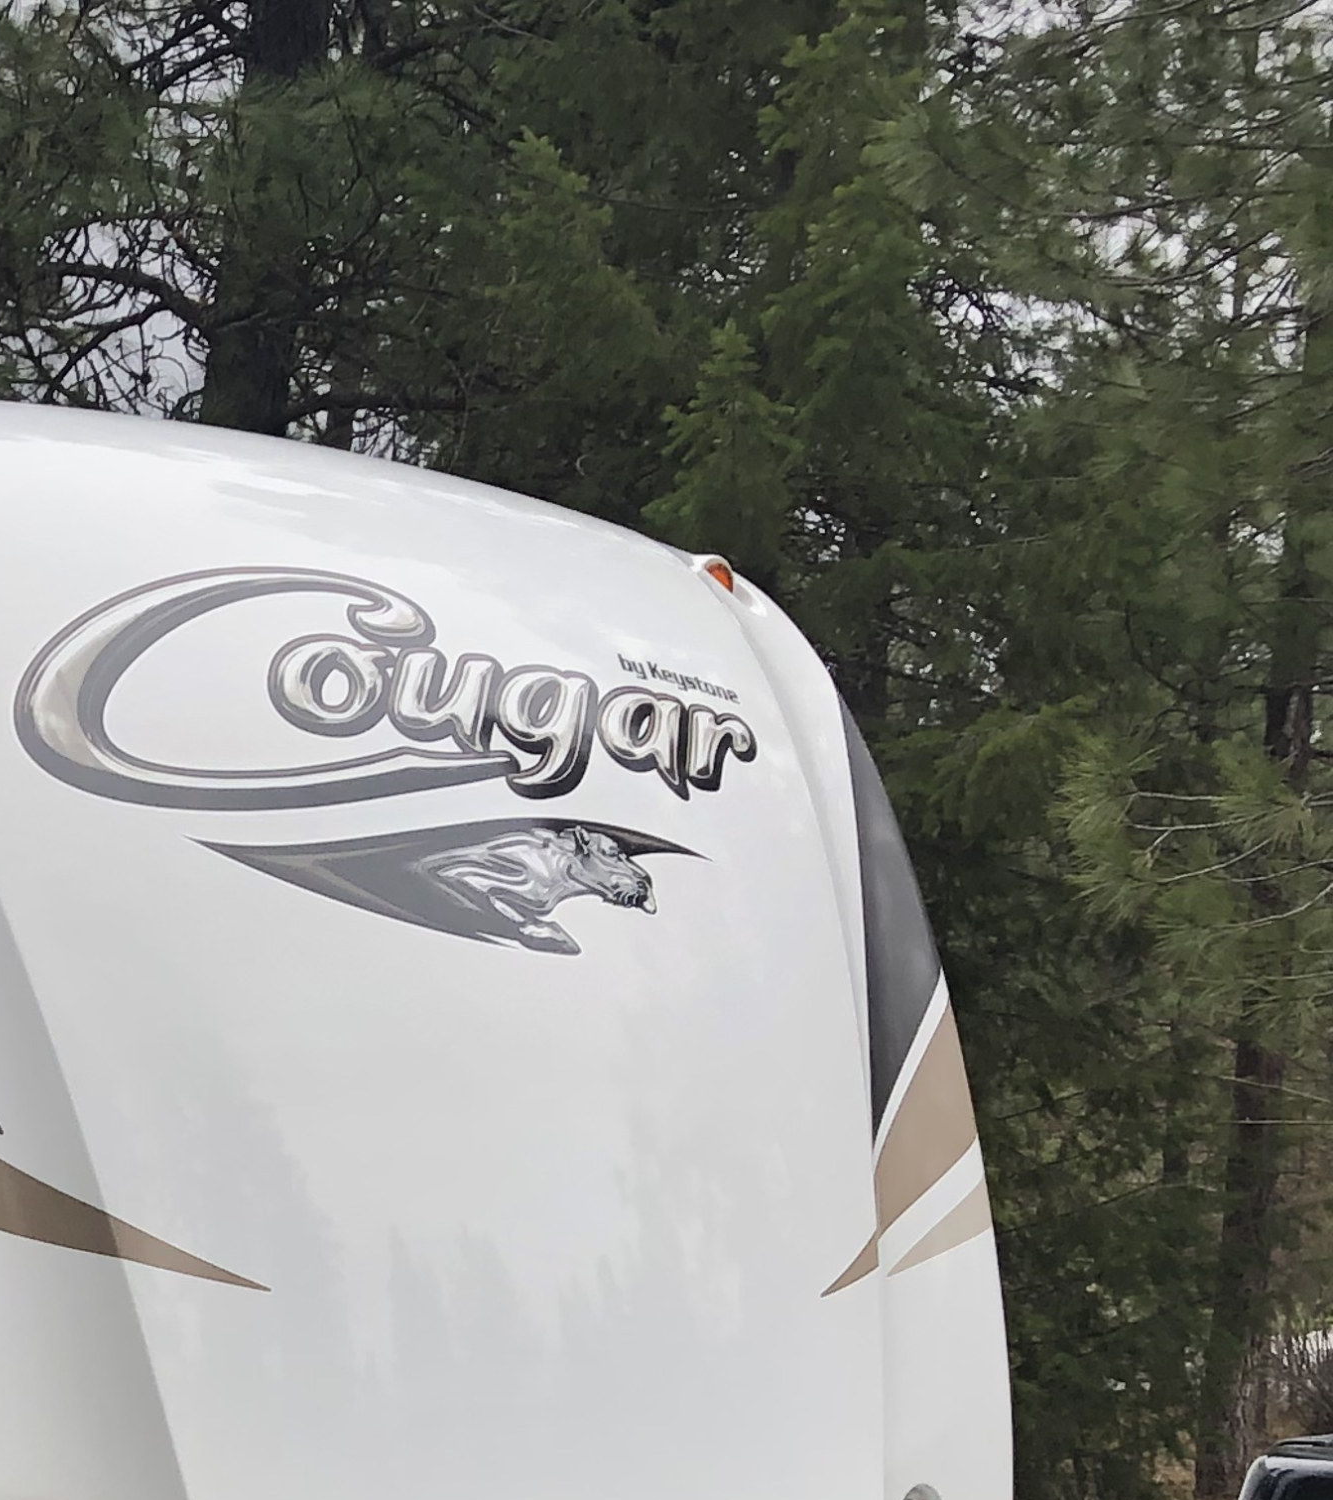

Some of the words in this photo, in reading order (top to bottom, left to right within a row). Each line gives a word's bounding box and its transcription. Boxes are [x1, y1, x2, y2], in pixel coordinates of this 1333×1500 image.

[13, 566, 757, 811] Cougar
[617, 653, 648, 680] by
[647, 661, 740, 704] Keystone
